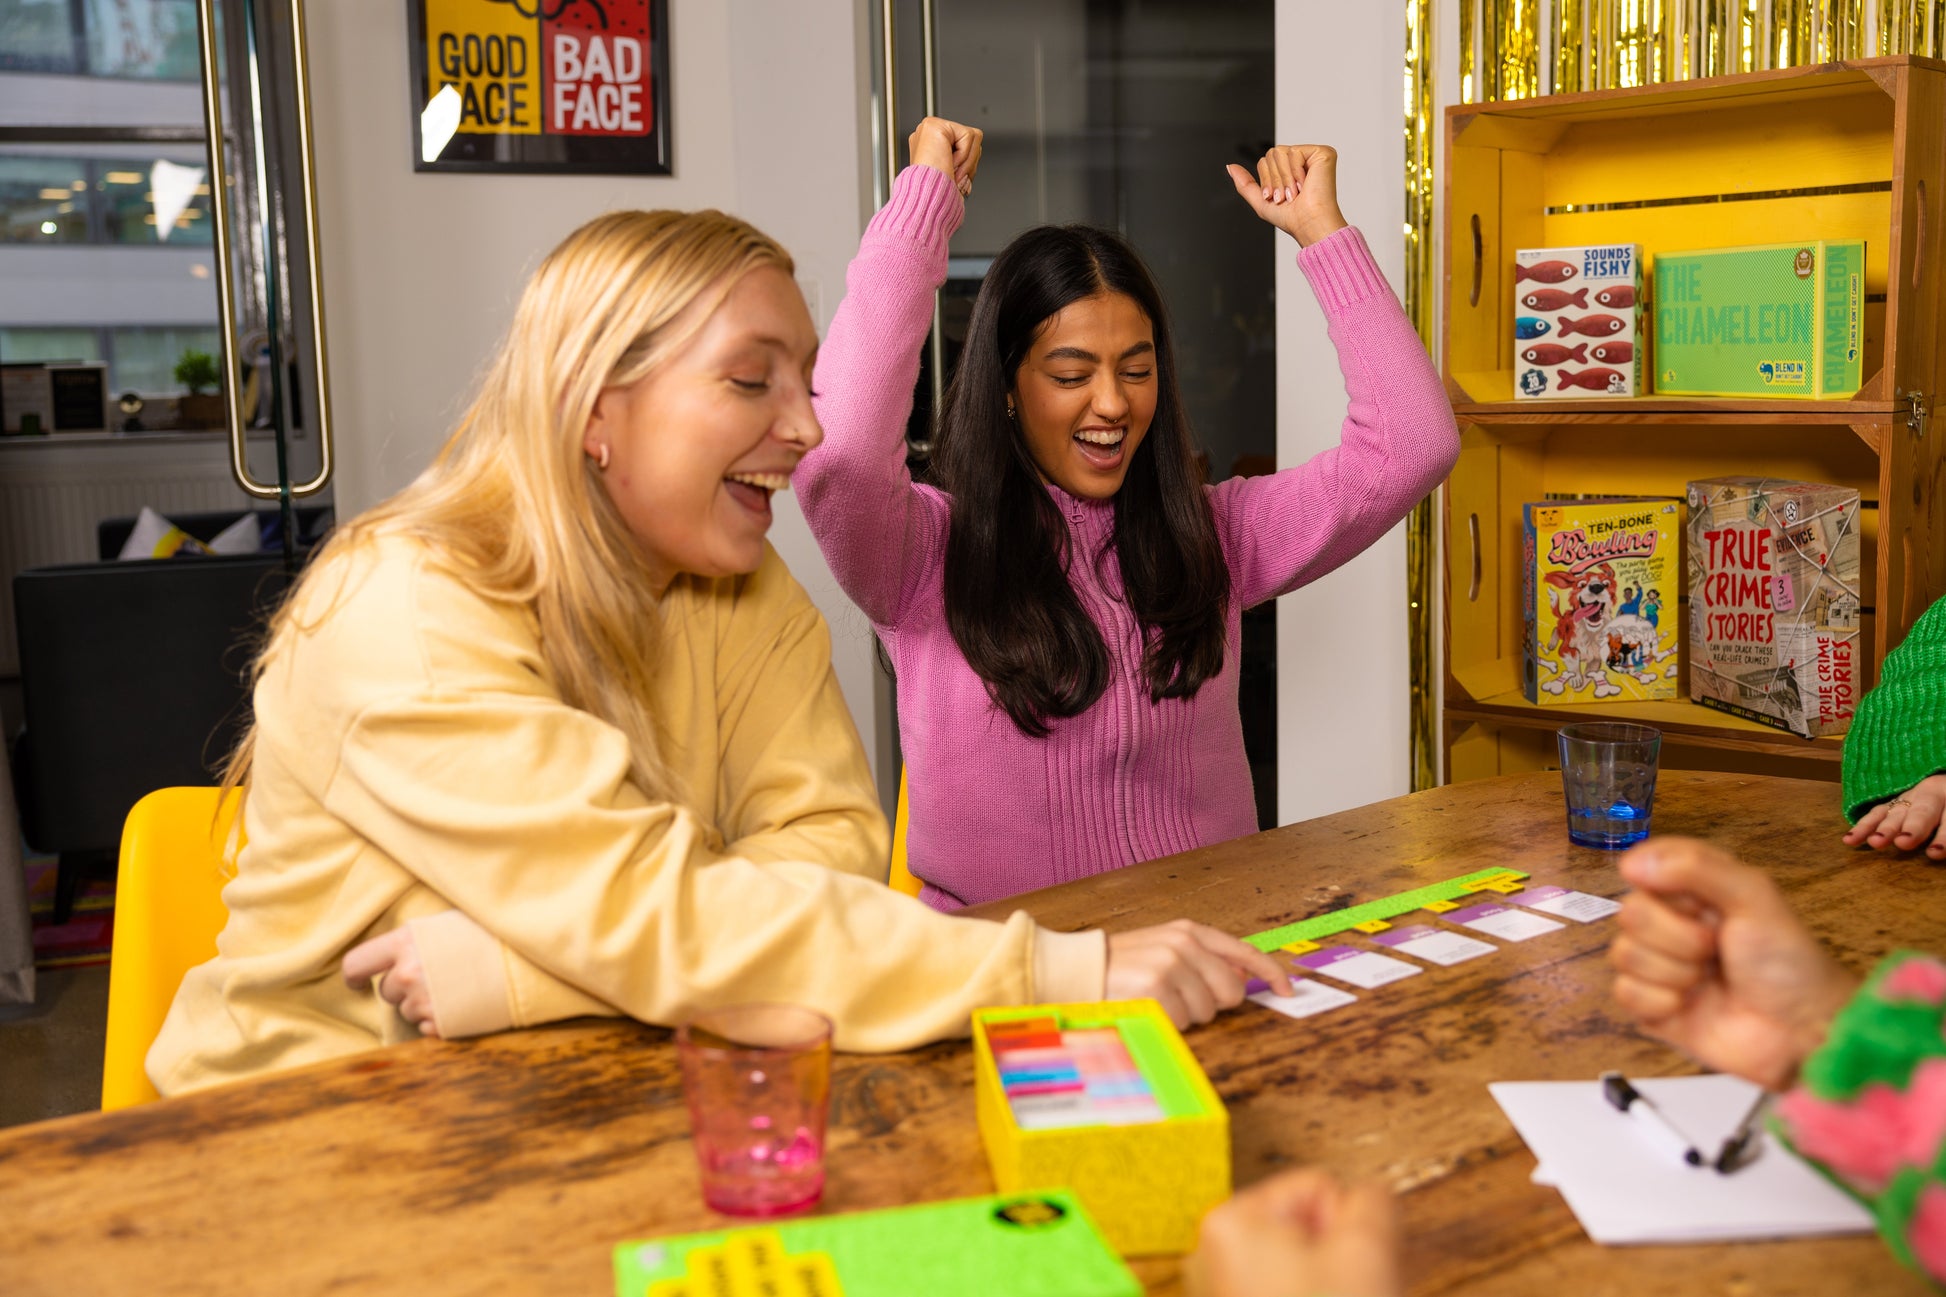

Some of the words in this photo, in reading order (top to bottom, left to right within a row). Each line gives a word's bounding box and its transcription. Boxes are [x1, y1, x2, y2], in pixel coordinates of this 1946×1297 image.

[438, 33, 526, 78] GOOD
[554, 34, 642, 83] BAD
[440, 82, 529, 126] ACE
[554, 83, 643, 131] FACE
[1584, 247, 1631, 261] SOUNDS
[1584, 260, 1631, 277] FISHY
[1658, 264, 1702, 303] THE
[1659, 302, 1811, 345] CHAMELEON
[1824, 247, 1848, 391] CHAMELEON
[1775, 363, 1795, 372] BLEND
[1796, 363, 1803, 372] IN
[1588, 514, 1654, 534] TEN-BONE
[1776, 527, 1815, 553] EVIDENCE
[1548, 529, 1658, 575] Bowling
[1704, 528, 1772, 571] TRUE
[1704, 572, 1772, 610] CRIME
[1778, 579, 1785, 595] 3
[1707, 613, 1774, 645] STORIES
[1709, 643, 1720, 651] CAN
[1722, 645, 1732, 655] YOU
[1734, 644, 1752, 654] CRACK
[1755, 646, 1773, 656] THESE
[1744, 655, 1769, 666] CRIMES?
[1817, 636, 1831, 682] CRIME
[1832, 640, 1853, 720] STORIES
[1818, 686, 1833, 726] TRUE
